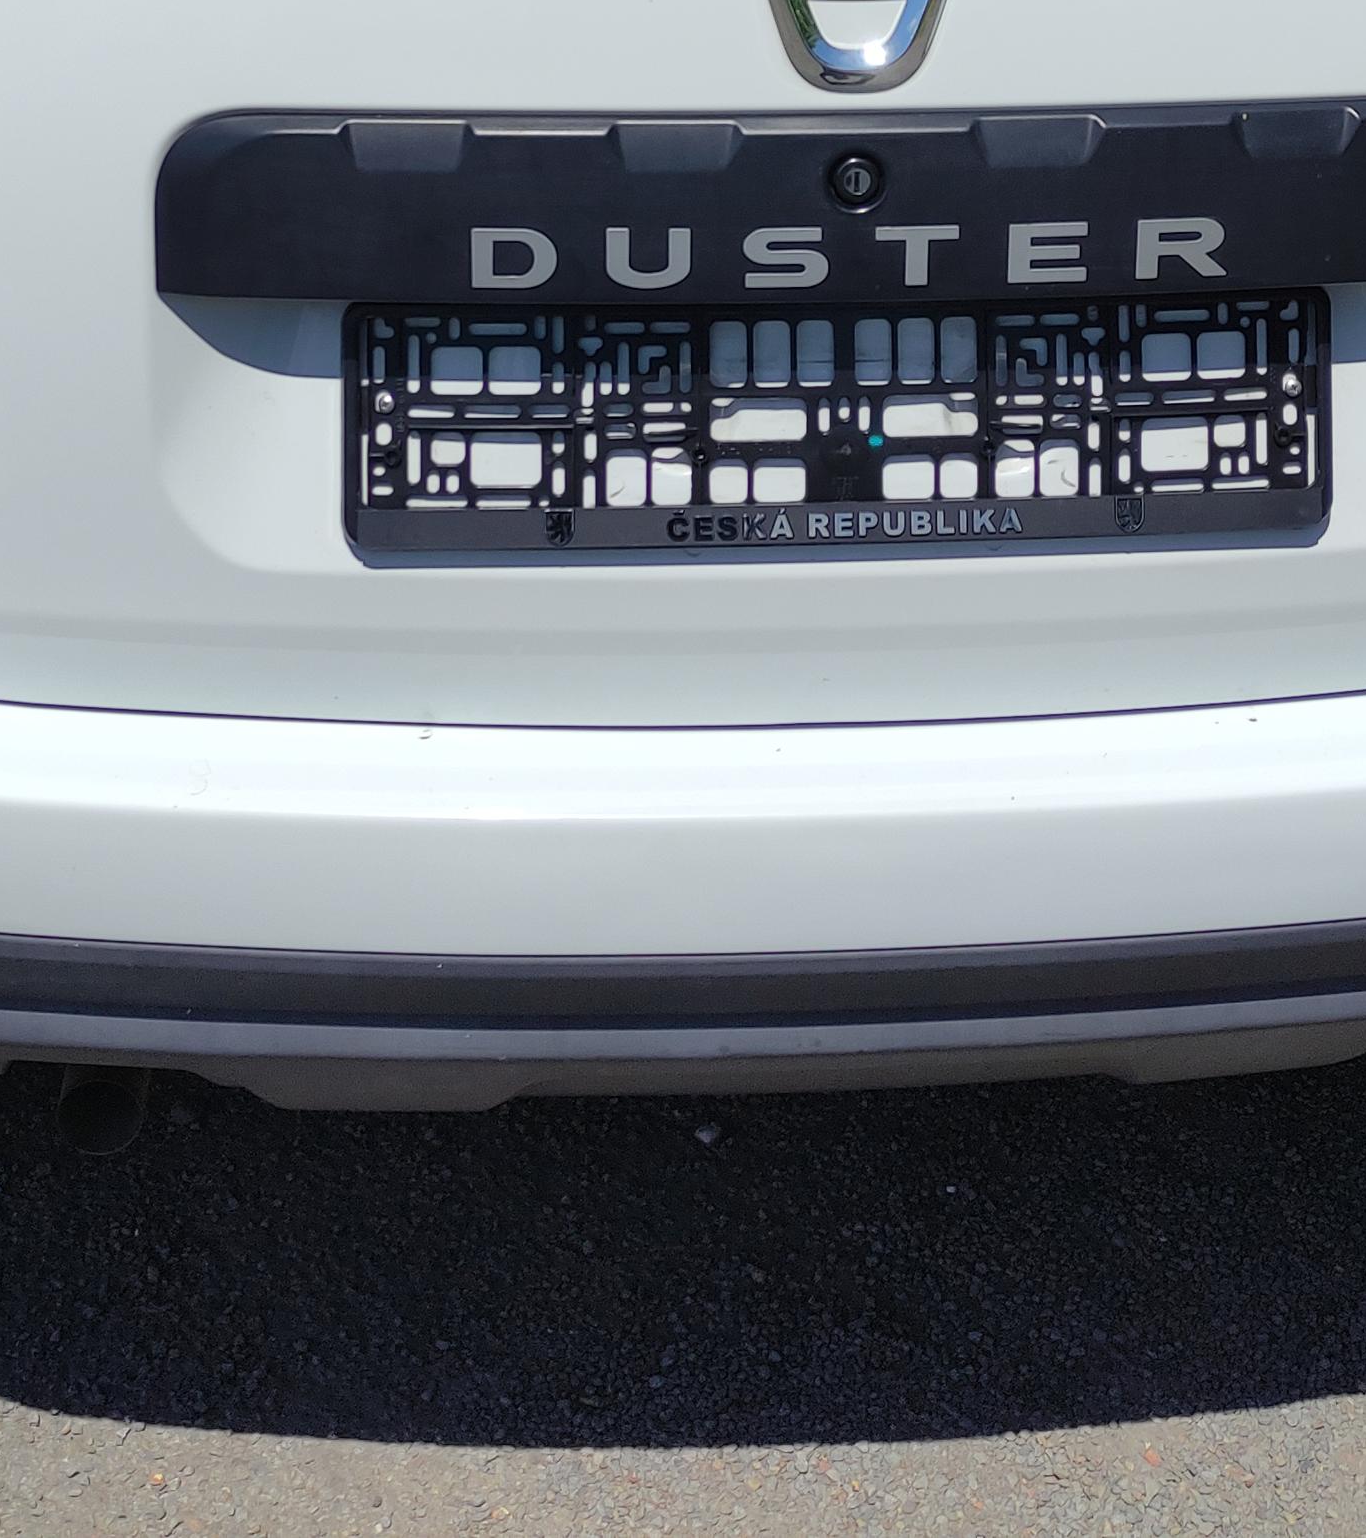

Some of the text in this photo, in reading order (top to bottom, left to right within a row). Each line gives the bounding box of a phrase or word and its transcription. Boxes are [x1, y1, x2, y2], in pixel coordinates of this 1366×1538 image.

[469, 217, 1228, 291] DUSTER
[666, 507, 1024, 543] ČESKÁ REPUBLIKA
